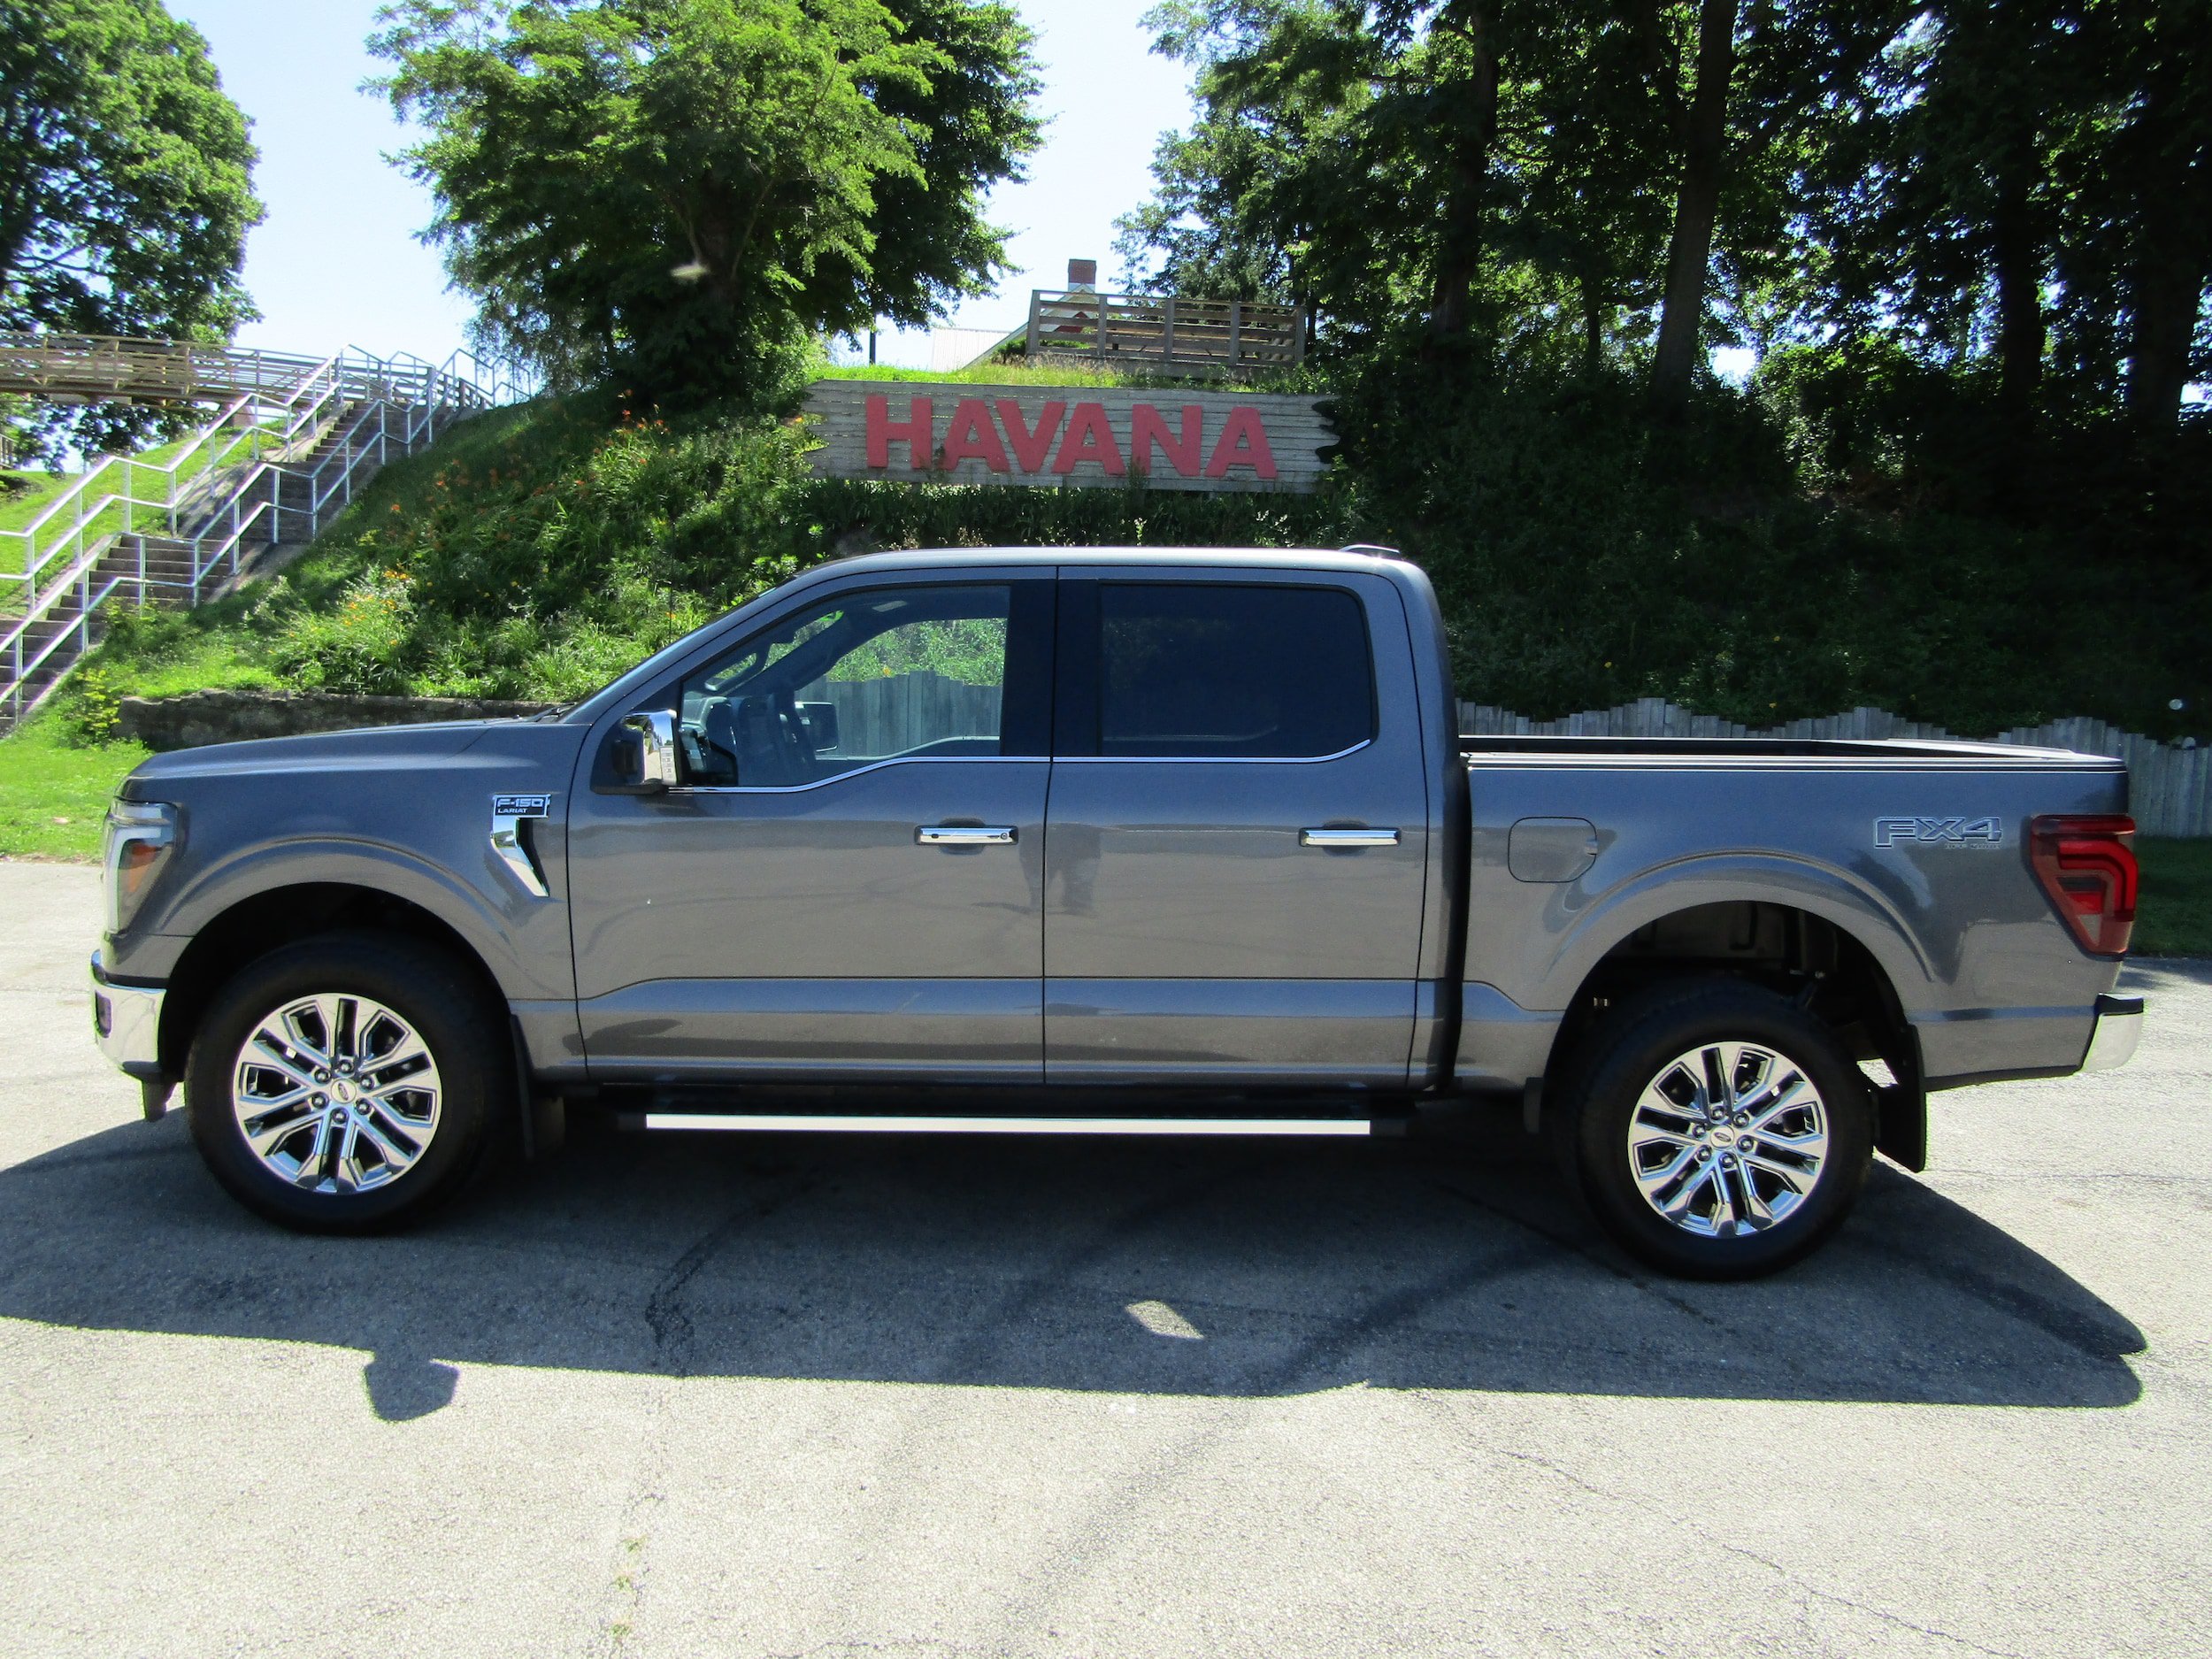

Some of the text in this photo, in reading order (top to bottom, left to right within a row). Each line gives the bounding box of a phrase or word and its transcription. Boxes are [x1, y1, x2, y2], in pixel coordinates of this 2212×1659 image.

[864, 395, 1278, 479] HAVANA
[497, 798, 544, 808] F-150
[1873, 817, 2002, 849] FX4
